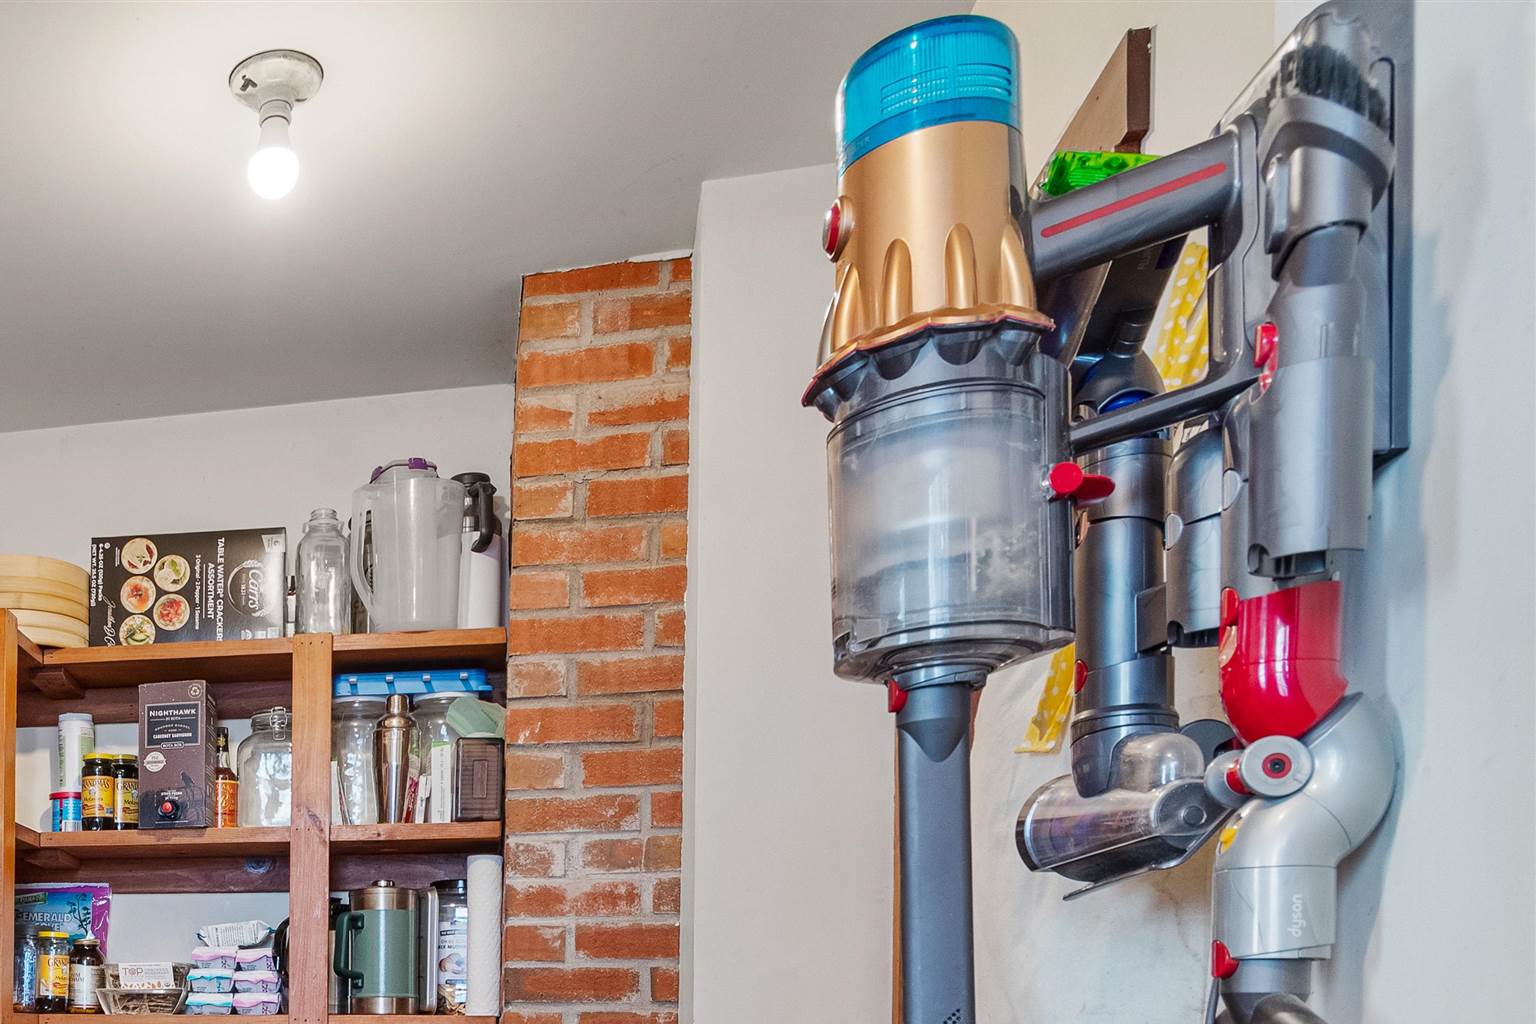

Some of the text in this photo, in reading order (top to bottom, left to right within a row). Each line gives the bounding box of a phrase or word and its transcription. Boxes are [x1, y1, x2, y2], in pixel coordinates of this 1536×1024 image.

[216, 537, 225, 562] TABLE
[149, 709, 196, 717] NIGHTHAWK
[22, 912, 71, 922] EMERALD
[1288, 894, 1306, 937] dyson
